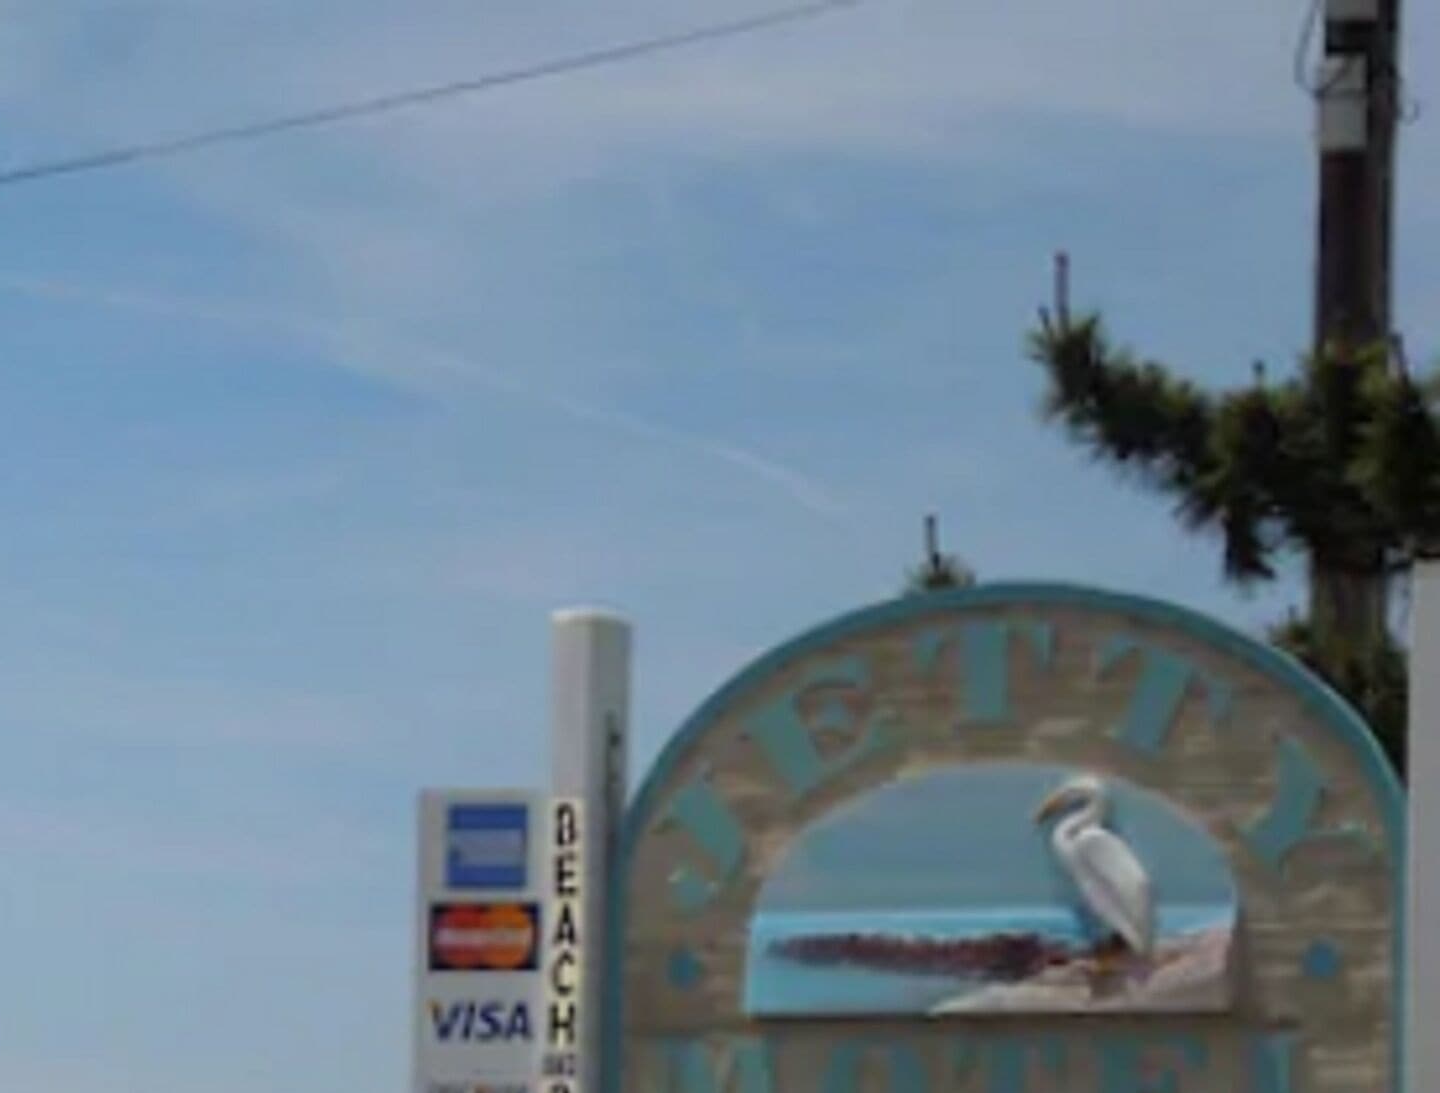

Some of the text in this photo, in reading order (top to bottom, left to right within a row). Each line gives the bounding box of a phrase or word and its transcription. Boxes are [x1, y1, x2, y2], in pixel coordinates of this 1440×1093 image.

[653, 619, 1382, 909] JETTY
[428, 1002, 532, 1040] VISA
[549, 804, 578, 1043] BEACH
